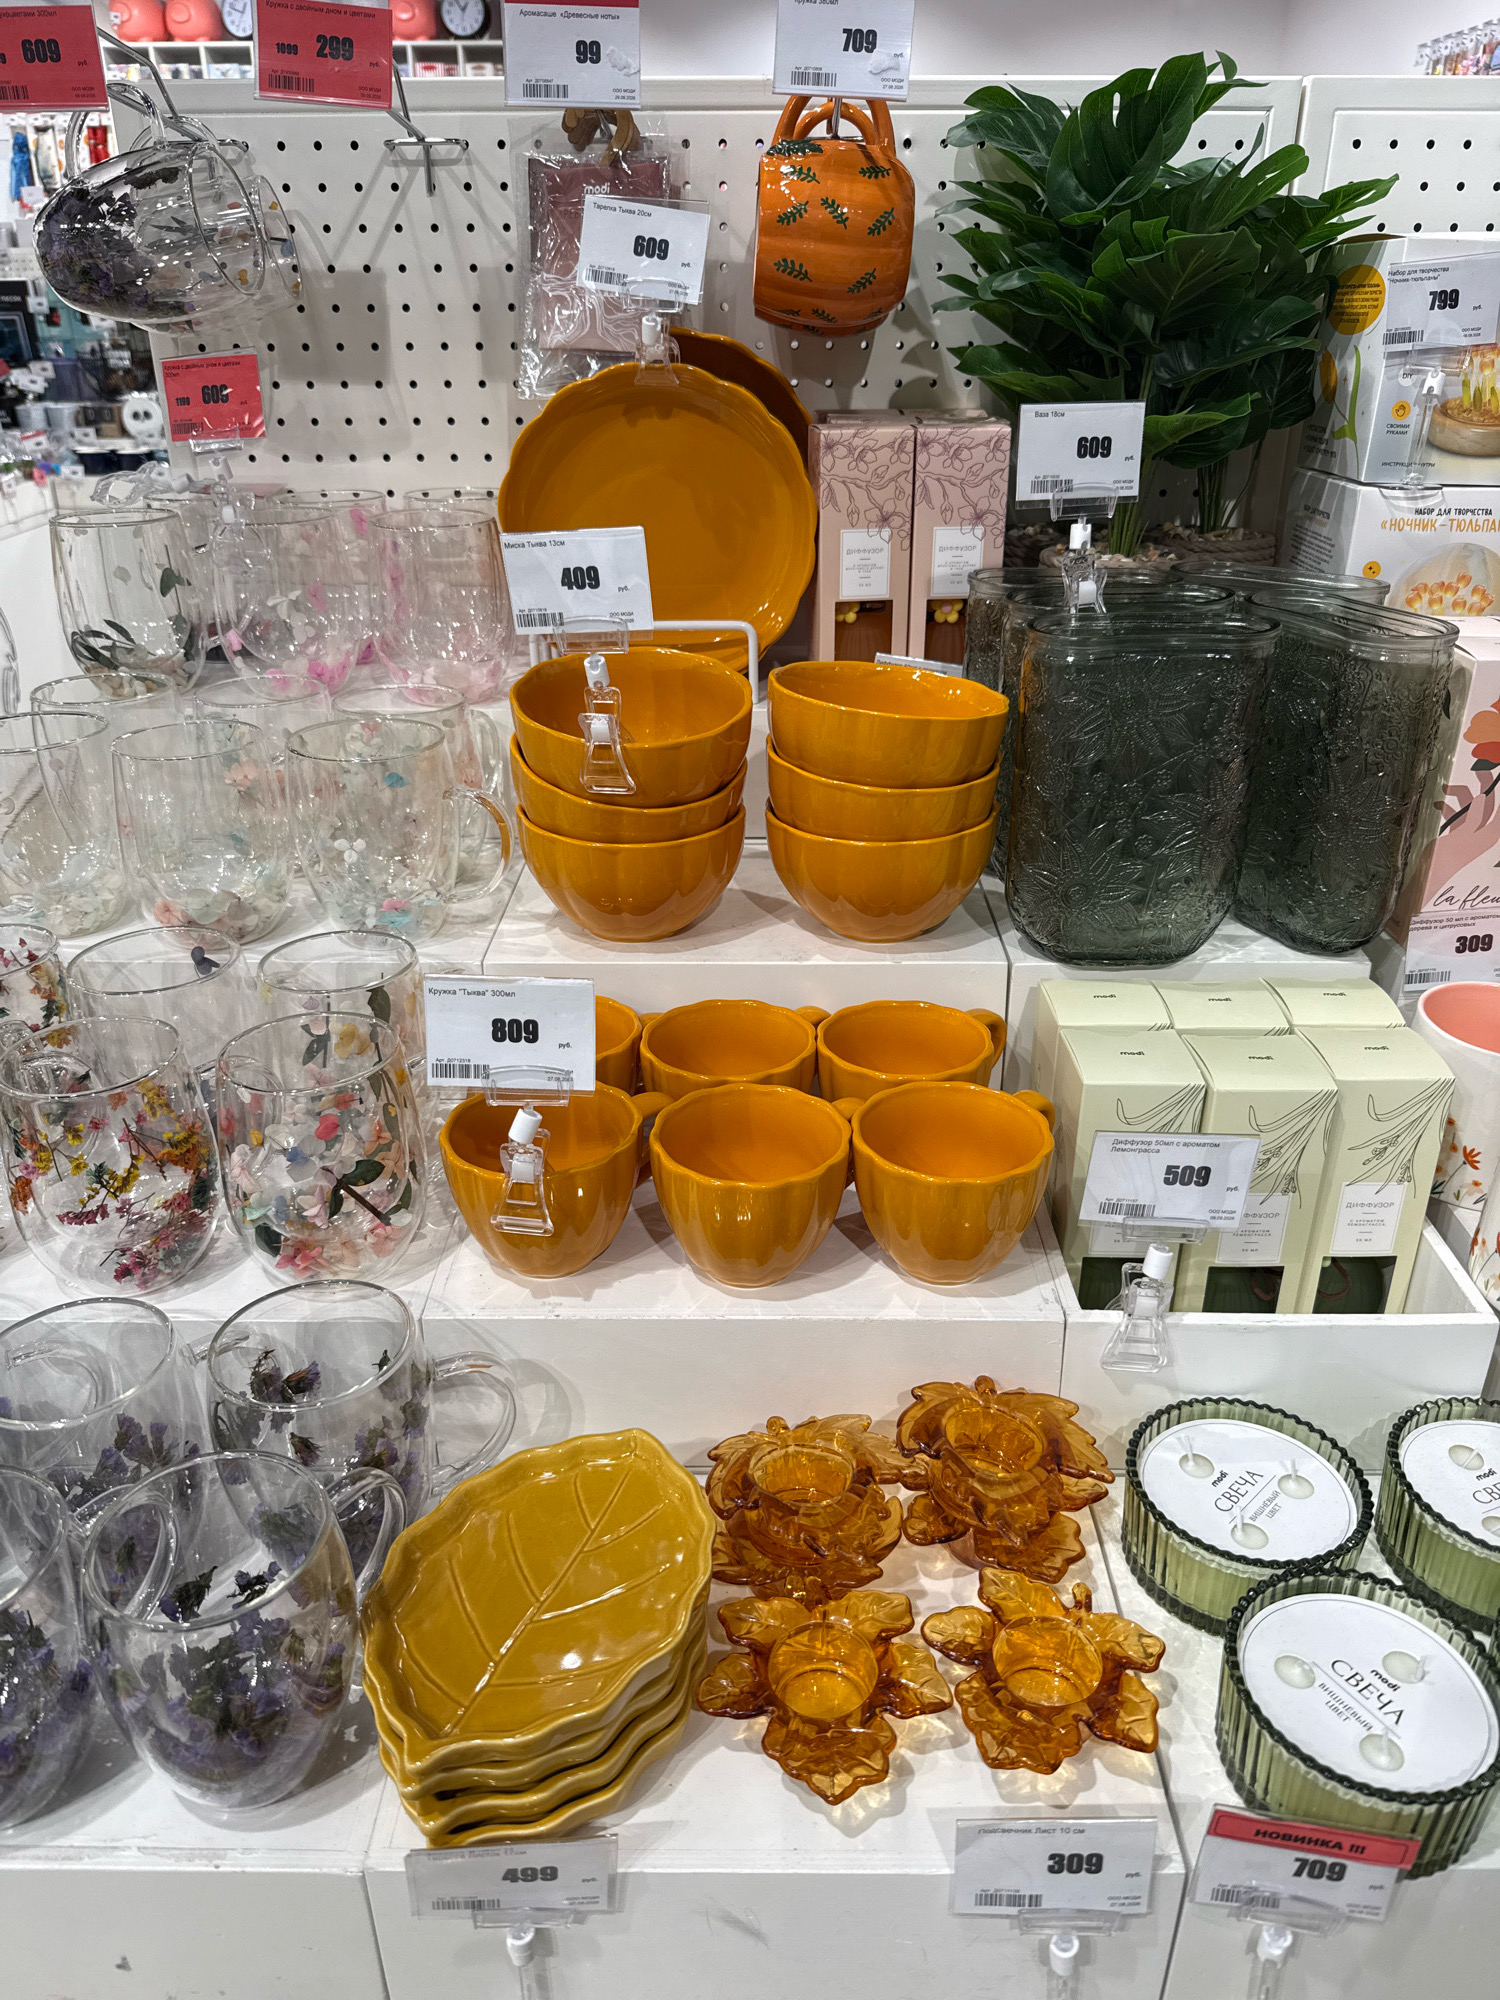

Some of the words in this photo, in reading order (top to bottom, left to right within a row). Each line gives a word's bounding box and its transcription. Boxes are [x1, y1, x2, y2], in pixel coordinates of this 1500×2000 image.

[519, 9, 557, 19] Аромасаше
[560, 11, 599, 20] «Древесные
[600, 13, 620, 21] ноты»
[275, 42, 299, 55] 1099
[316, 34, 354, 61] 299
[842, 28, 878, 53] 709
[21, 39, 61, 64] 609
[575, 39, 602, 65] 99
[583, 182, 611, 195] modi
[593, 201, 617, 213] Тарелка
[618, 206, 636, 216] Тыква
[637, 209, 652, 218] 20см
[633, 235, 670, 261] 609
[1387, 269, 1406, 278] Набор
[1407, 268, 1418, 276] для
[1418, 266, 1450, 275] творчества
[1428, 288, 1460, 311] 799
[201, 384, 230, 405] 609
[1076, 436, 1113, 459] 609
[1414, 508, 1435, 516] НАБОР
[1436, 507, 1452, 517] ДЛЯ
[1454, 507, 1493, 516] ТВОРЧЕСТВА
[504, 541, 526, 550] Миска
[528, 539, 548, 549] Тыква
[549, 539, 565, 548] 13см
[846, 547, 884, 556] ДИФФУЗОР
[938, 545, 976, 553] ДИФФУЗОР
[560, 565, 601, 591] 409
[617, 585, 630, 593] руб.
[1433, 885, 1461, 907] la
[1439, 922, 1476, 930] цитрусовых
[1454, 933, 1494, 954] 309
[428, 987, 457, 998] Кружка
[458, 988, 489, 998] "Тыква"
[490, 989, 516, 998] 300мл
[491, 1017, 540, 1045] 809
[558, 1042, 573, 1050] руб.
[1110, 1147, 1160, 1155] Лемонграсса
[1112, 1138, 1152, 1148] Диффузор
[1154, 1139, 1174, 1147] 50мл
[1182, 1141, 1221, 1149] ароматом
[1163, 1165, 1212, 1188] 509
[1345, 1201, 1395, 1209] ДИФФУЗОР
[1243, 1212, 1280, 1220] ФФУЗОР
[1211, 1469, 1229, 1488] modi
[1475, 1467, 1498, 1481] modi
[1214, 1470, 1264, 1513] СВЕЧА
[1249, 1490, 1281, 1522] ВИШНЕВЫЙ
[1265, 1503, 1282, 1519] ЦВЕТ
[1370, 1669, 1401, 1692] modi
[1331, 1659, 1404, 1726] СВЕЧА
[1318, 1682, 1374, 1732] ВИШНЕВЫЙ
[1325, 1700, 1351, 1723] ЦВЕТ
[978, 1827, 1033, 1835] Подсвечник
[1254, 1828, 1343, 1852] НОВИНКА
[1047, 1852, 1104, 1875] 309
[1292, 1857, 1348, 1882] 709
[501, 1865, 559, 1884] 499
